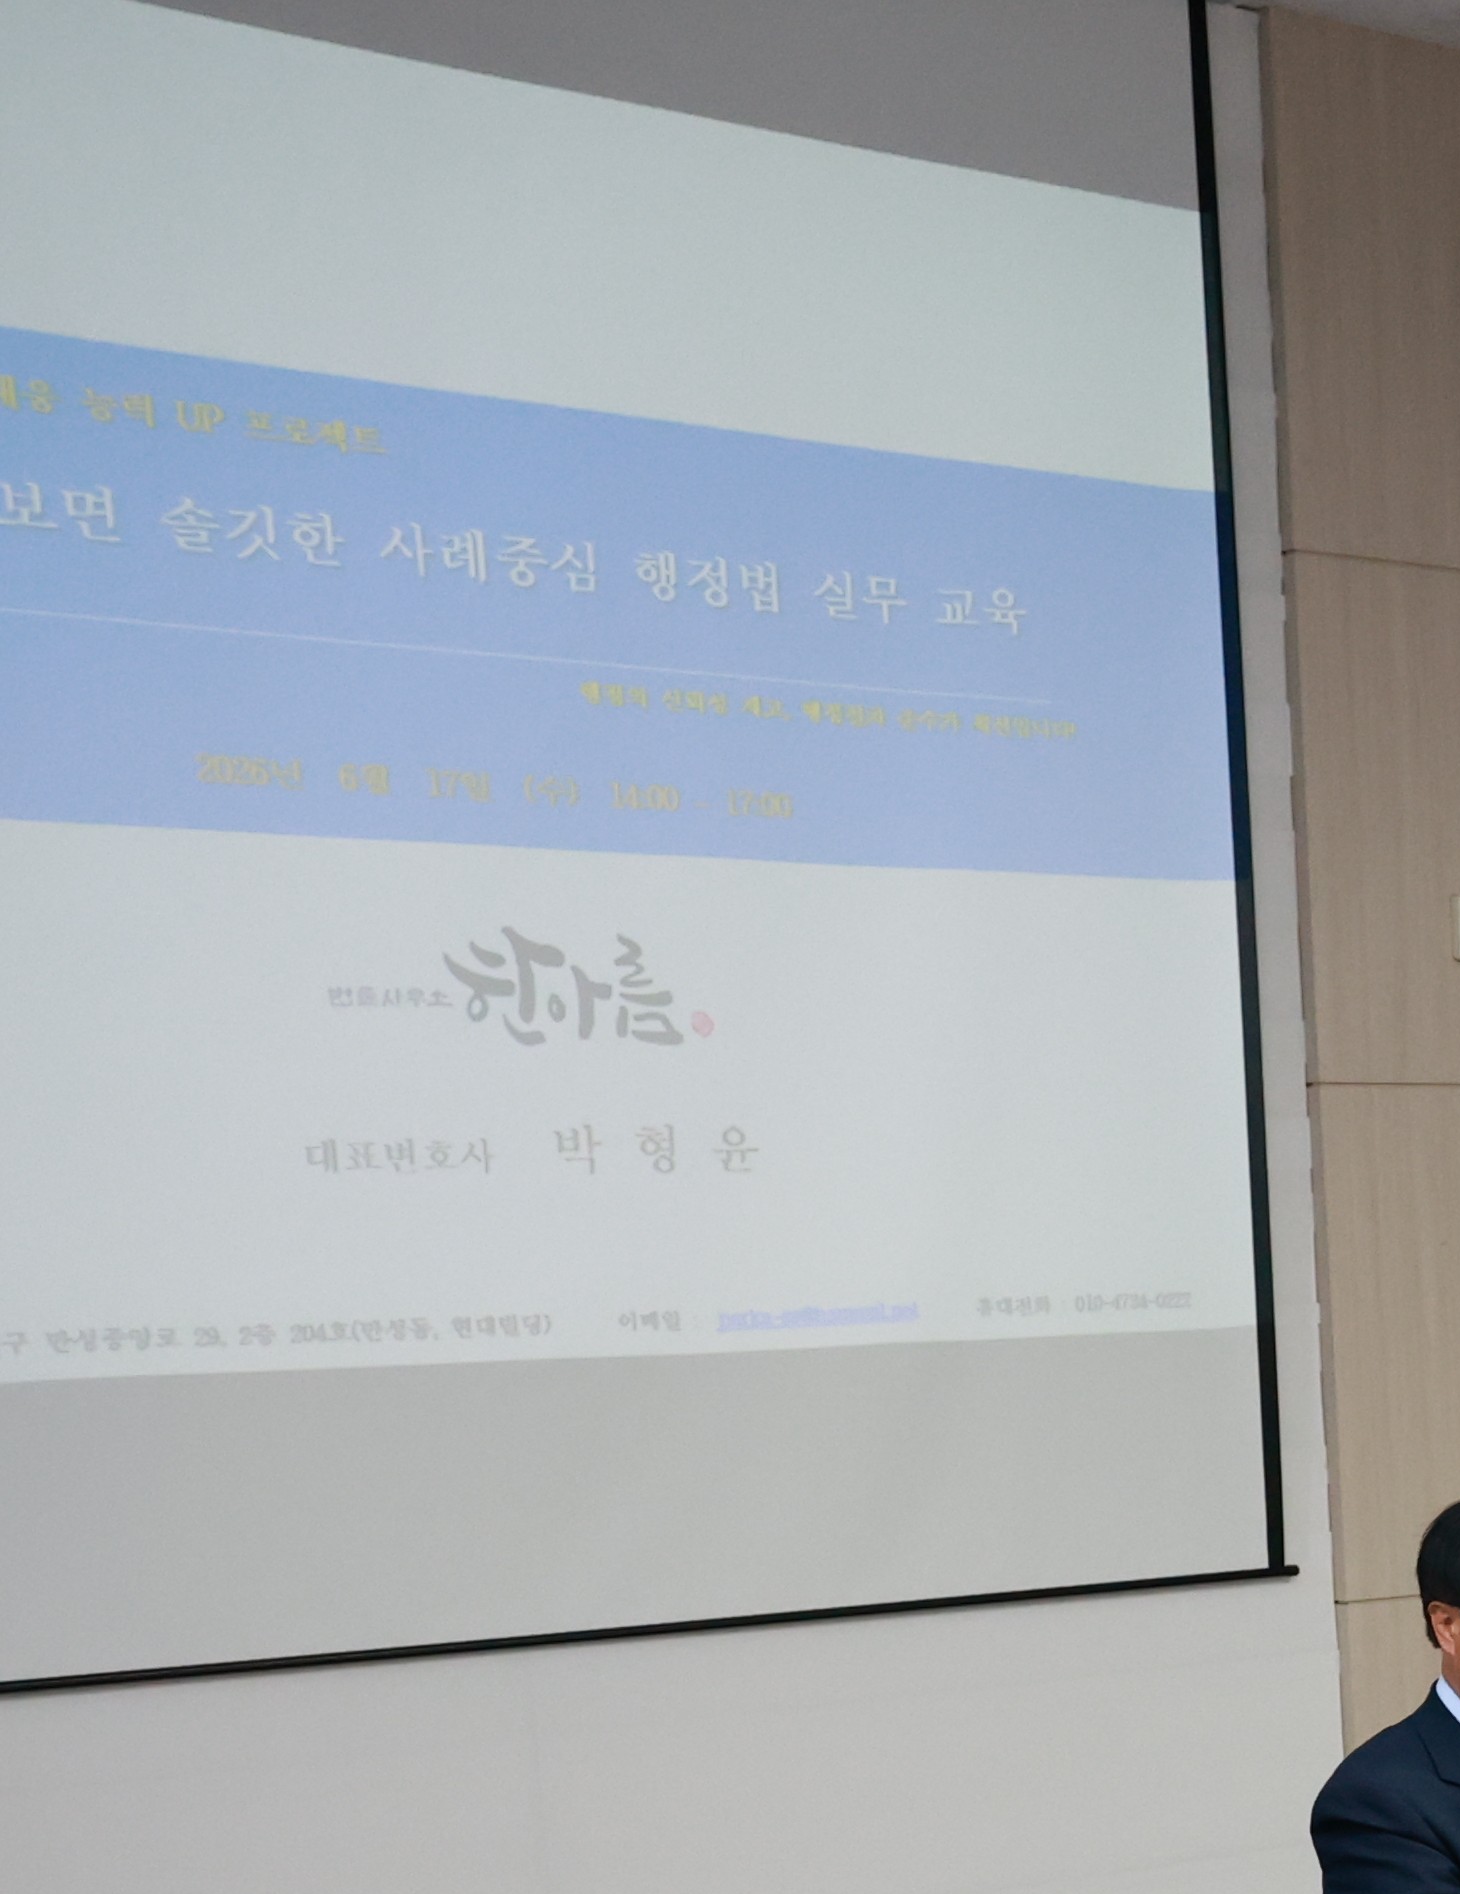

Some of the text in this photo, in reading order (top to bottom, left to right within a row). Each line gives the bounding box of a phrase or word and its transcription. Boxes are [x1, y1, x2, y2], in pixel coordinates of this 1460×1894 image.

[175, 399, 227, 434] UP
[244, 409, 388, 455] 프로젝트
[0, 482, 1027, 635] 보면 솔깃한 사례중심 행정법 실무 교육
[304, 1134, 494, 1177] 대표변호사
